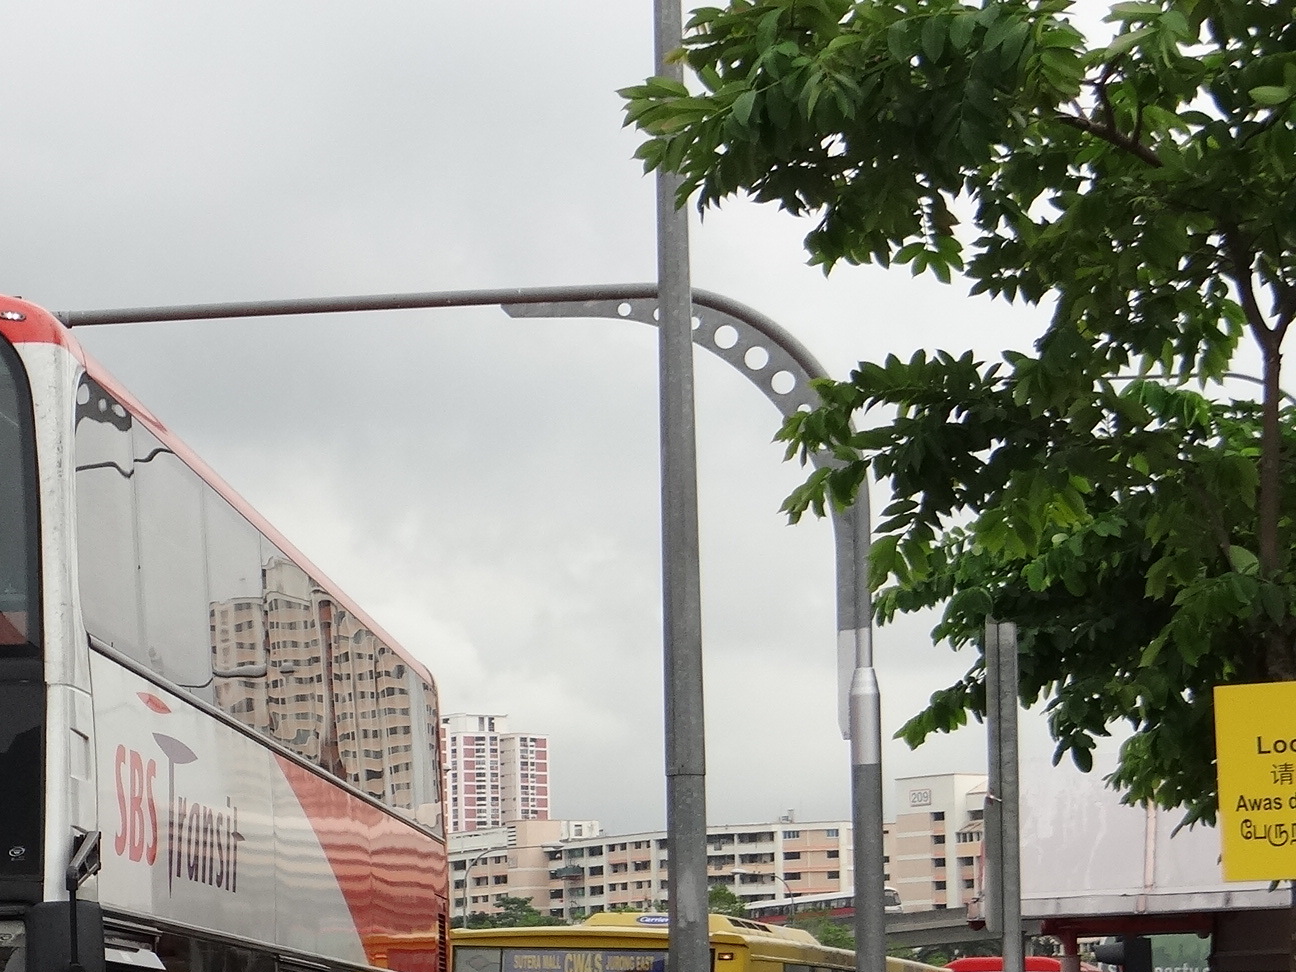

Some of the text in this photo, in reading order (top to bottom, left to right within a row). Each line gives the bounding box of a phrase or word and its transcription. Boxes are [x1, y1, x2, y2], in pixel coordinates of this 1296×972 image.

[911, 791, 929, 804] 209
[1235, 794, 1283, 812] Awas
[114, 732, 245, 899] SBS Transit
